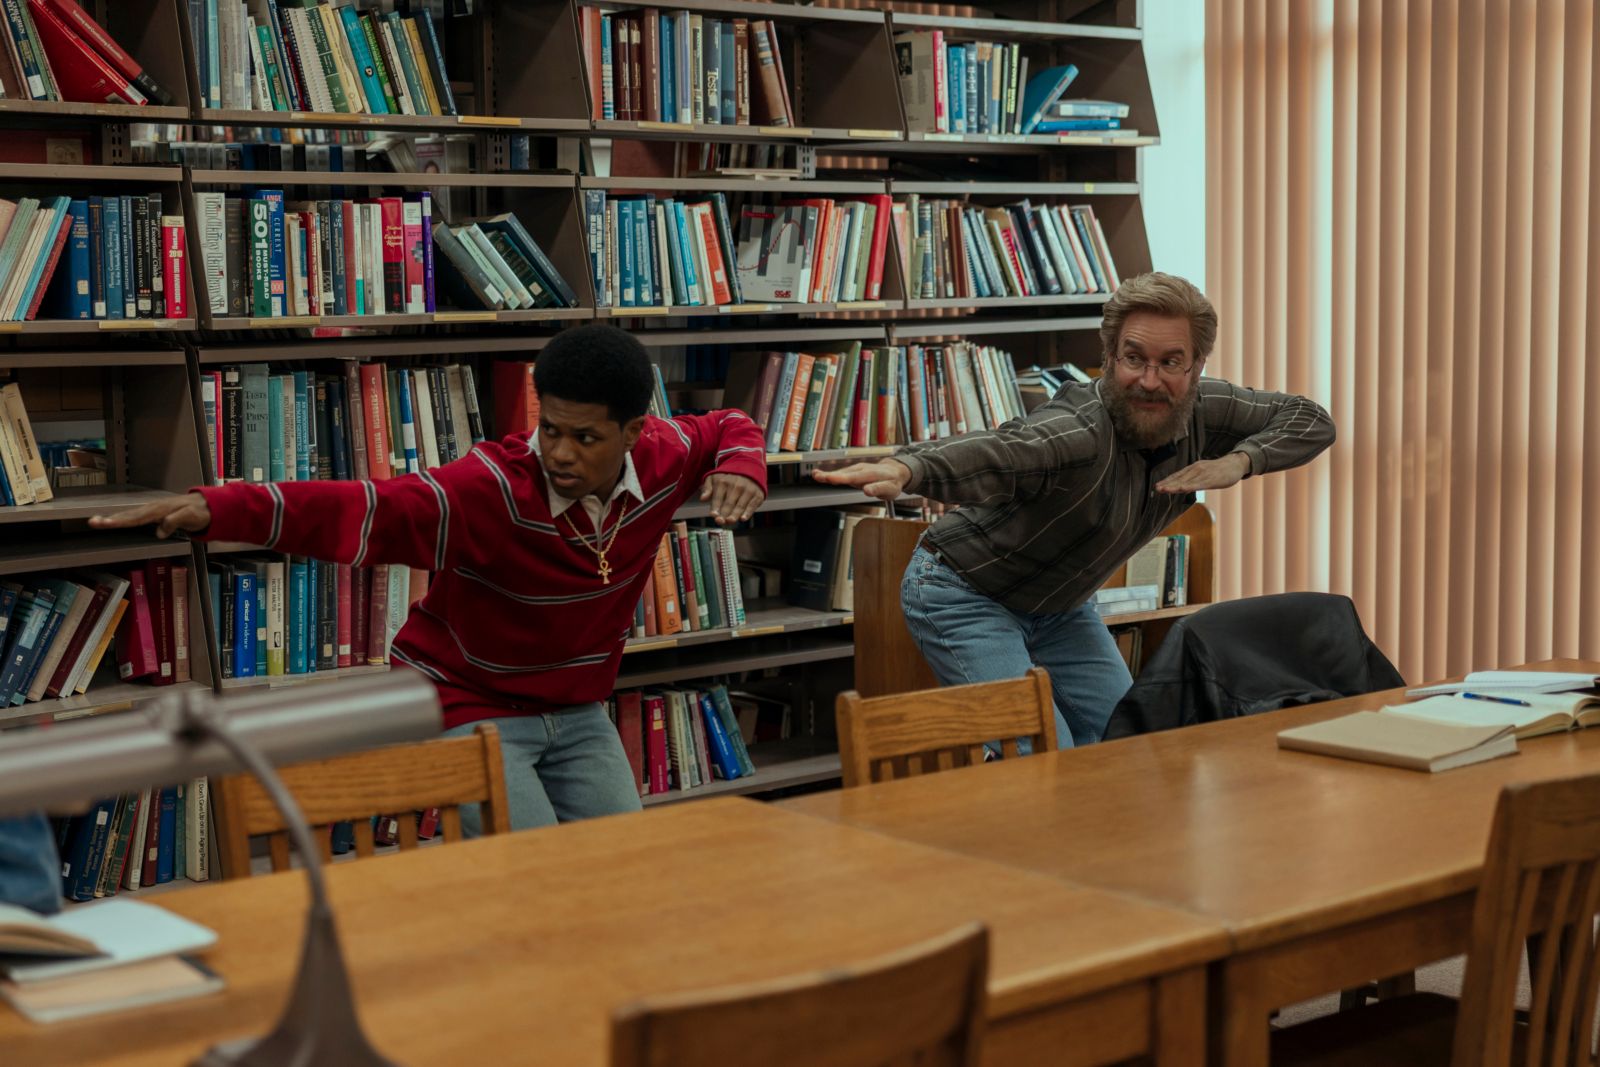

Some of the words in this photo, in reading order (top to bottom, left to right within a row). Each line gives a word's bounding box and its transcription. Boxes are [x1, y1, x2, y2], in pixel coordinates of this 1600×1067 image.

[204, 196, 222, 217] Tom
[204, 217, 223, 250] Clancy
[254, 203, 269, 249] 501
[274, 218, 282, 253] CURRENT
[261, 249, 269, 300] MUST-READ
[244, 391, 267, 399] TESTS
[246, 413, 268, 421] PRINT
[247, 424, 256, 432] III
[243, 579, 249, 588] 5
[198, 812, 204, 820] Up
